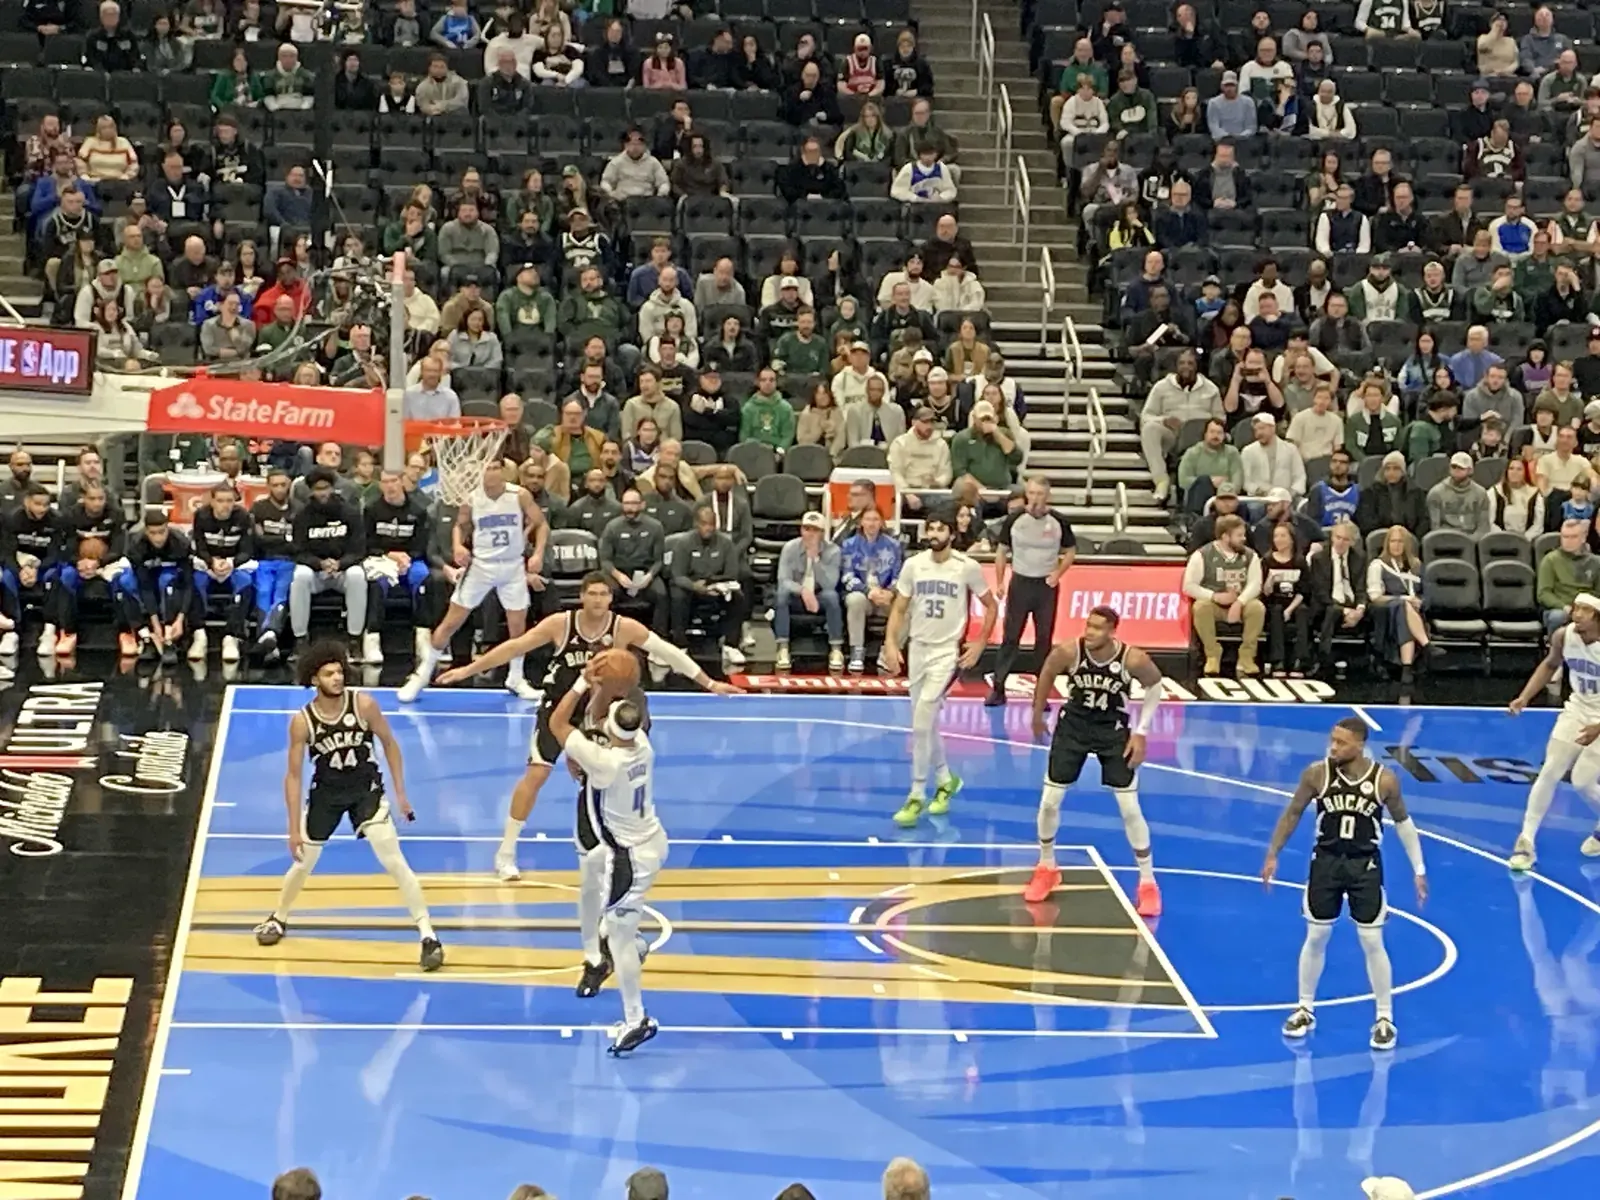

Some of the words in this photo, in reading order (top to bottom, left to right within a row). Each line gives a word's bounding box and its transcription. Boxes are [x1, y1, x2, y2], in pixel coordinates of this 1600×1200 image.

[39, 342, 79, 384] App
[490, 531, 510, 547] 23
[916, 579, 958, 599] MAGIC
[925, 599, 945, 619] 35
[1069, 590, 1104, 619] FLY
[1108, 591, 1180, 620] BETTER
[564, 651, 593, 667] BUC
[746, 675, 910, 688] Emirat
[1073, 674, 1122, 694] BUCKS
[1197, 677, 1336, 702] CUP
[1082, 690, 1109, 711] 34
[7, 682, 104, 751] ULTRA
[314, 731, 364, 755] BUCKS
[328, 747, 359, 771] 44
[632, 784, 646, 818] 4
[1322, 793, 1378, 817] BUCKS
[1340, 815, 1355, 839] 0
